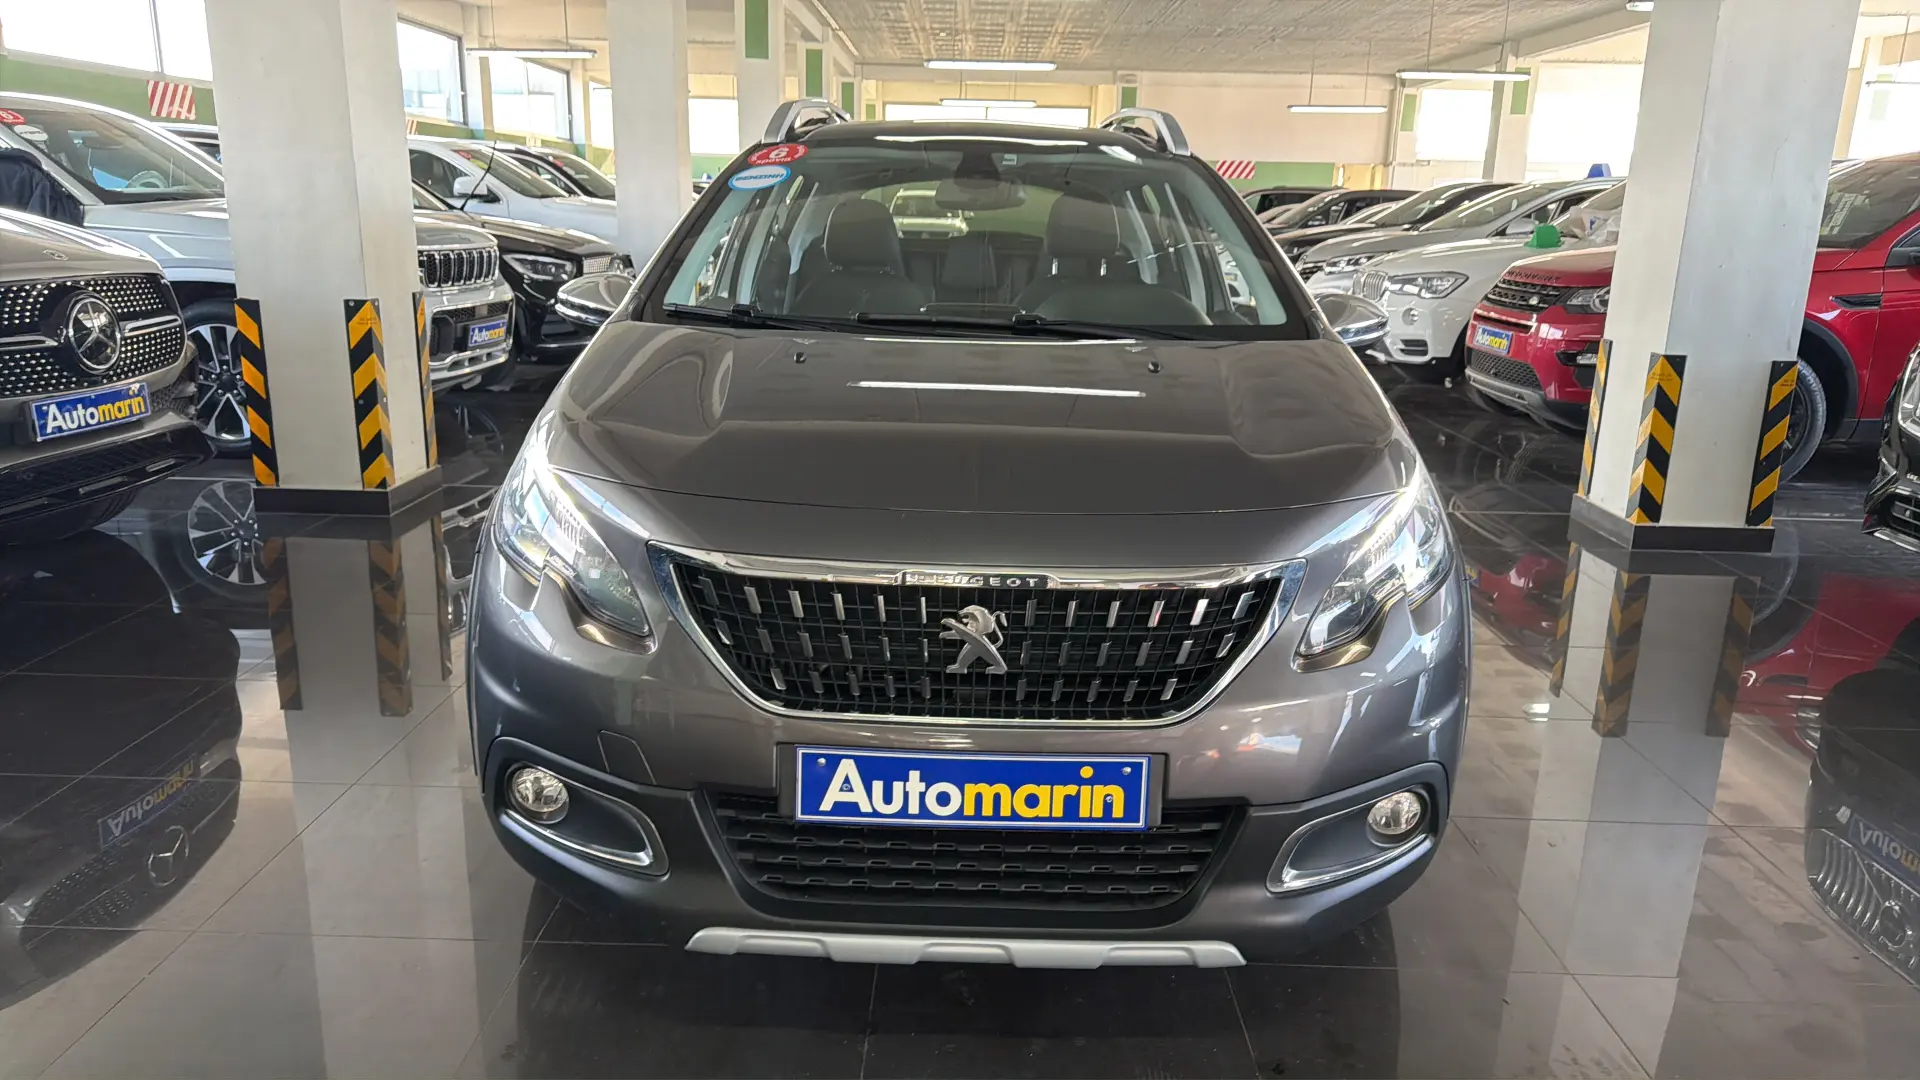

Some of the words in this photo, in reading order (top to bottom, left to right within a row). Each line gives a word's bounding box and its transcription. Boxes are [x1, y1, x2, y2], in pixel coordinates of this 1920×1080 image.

[769, 147, 790, 159] 6
[46, 389, 145, 433] Automarin
[819, 759, 1125, 818] Automarin
